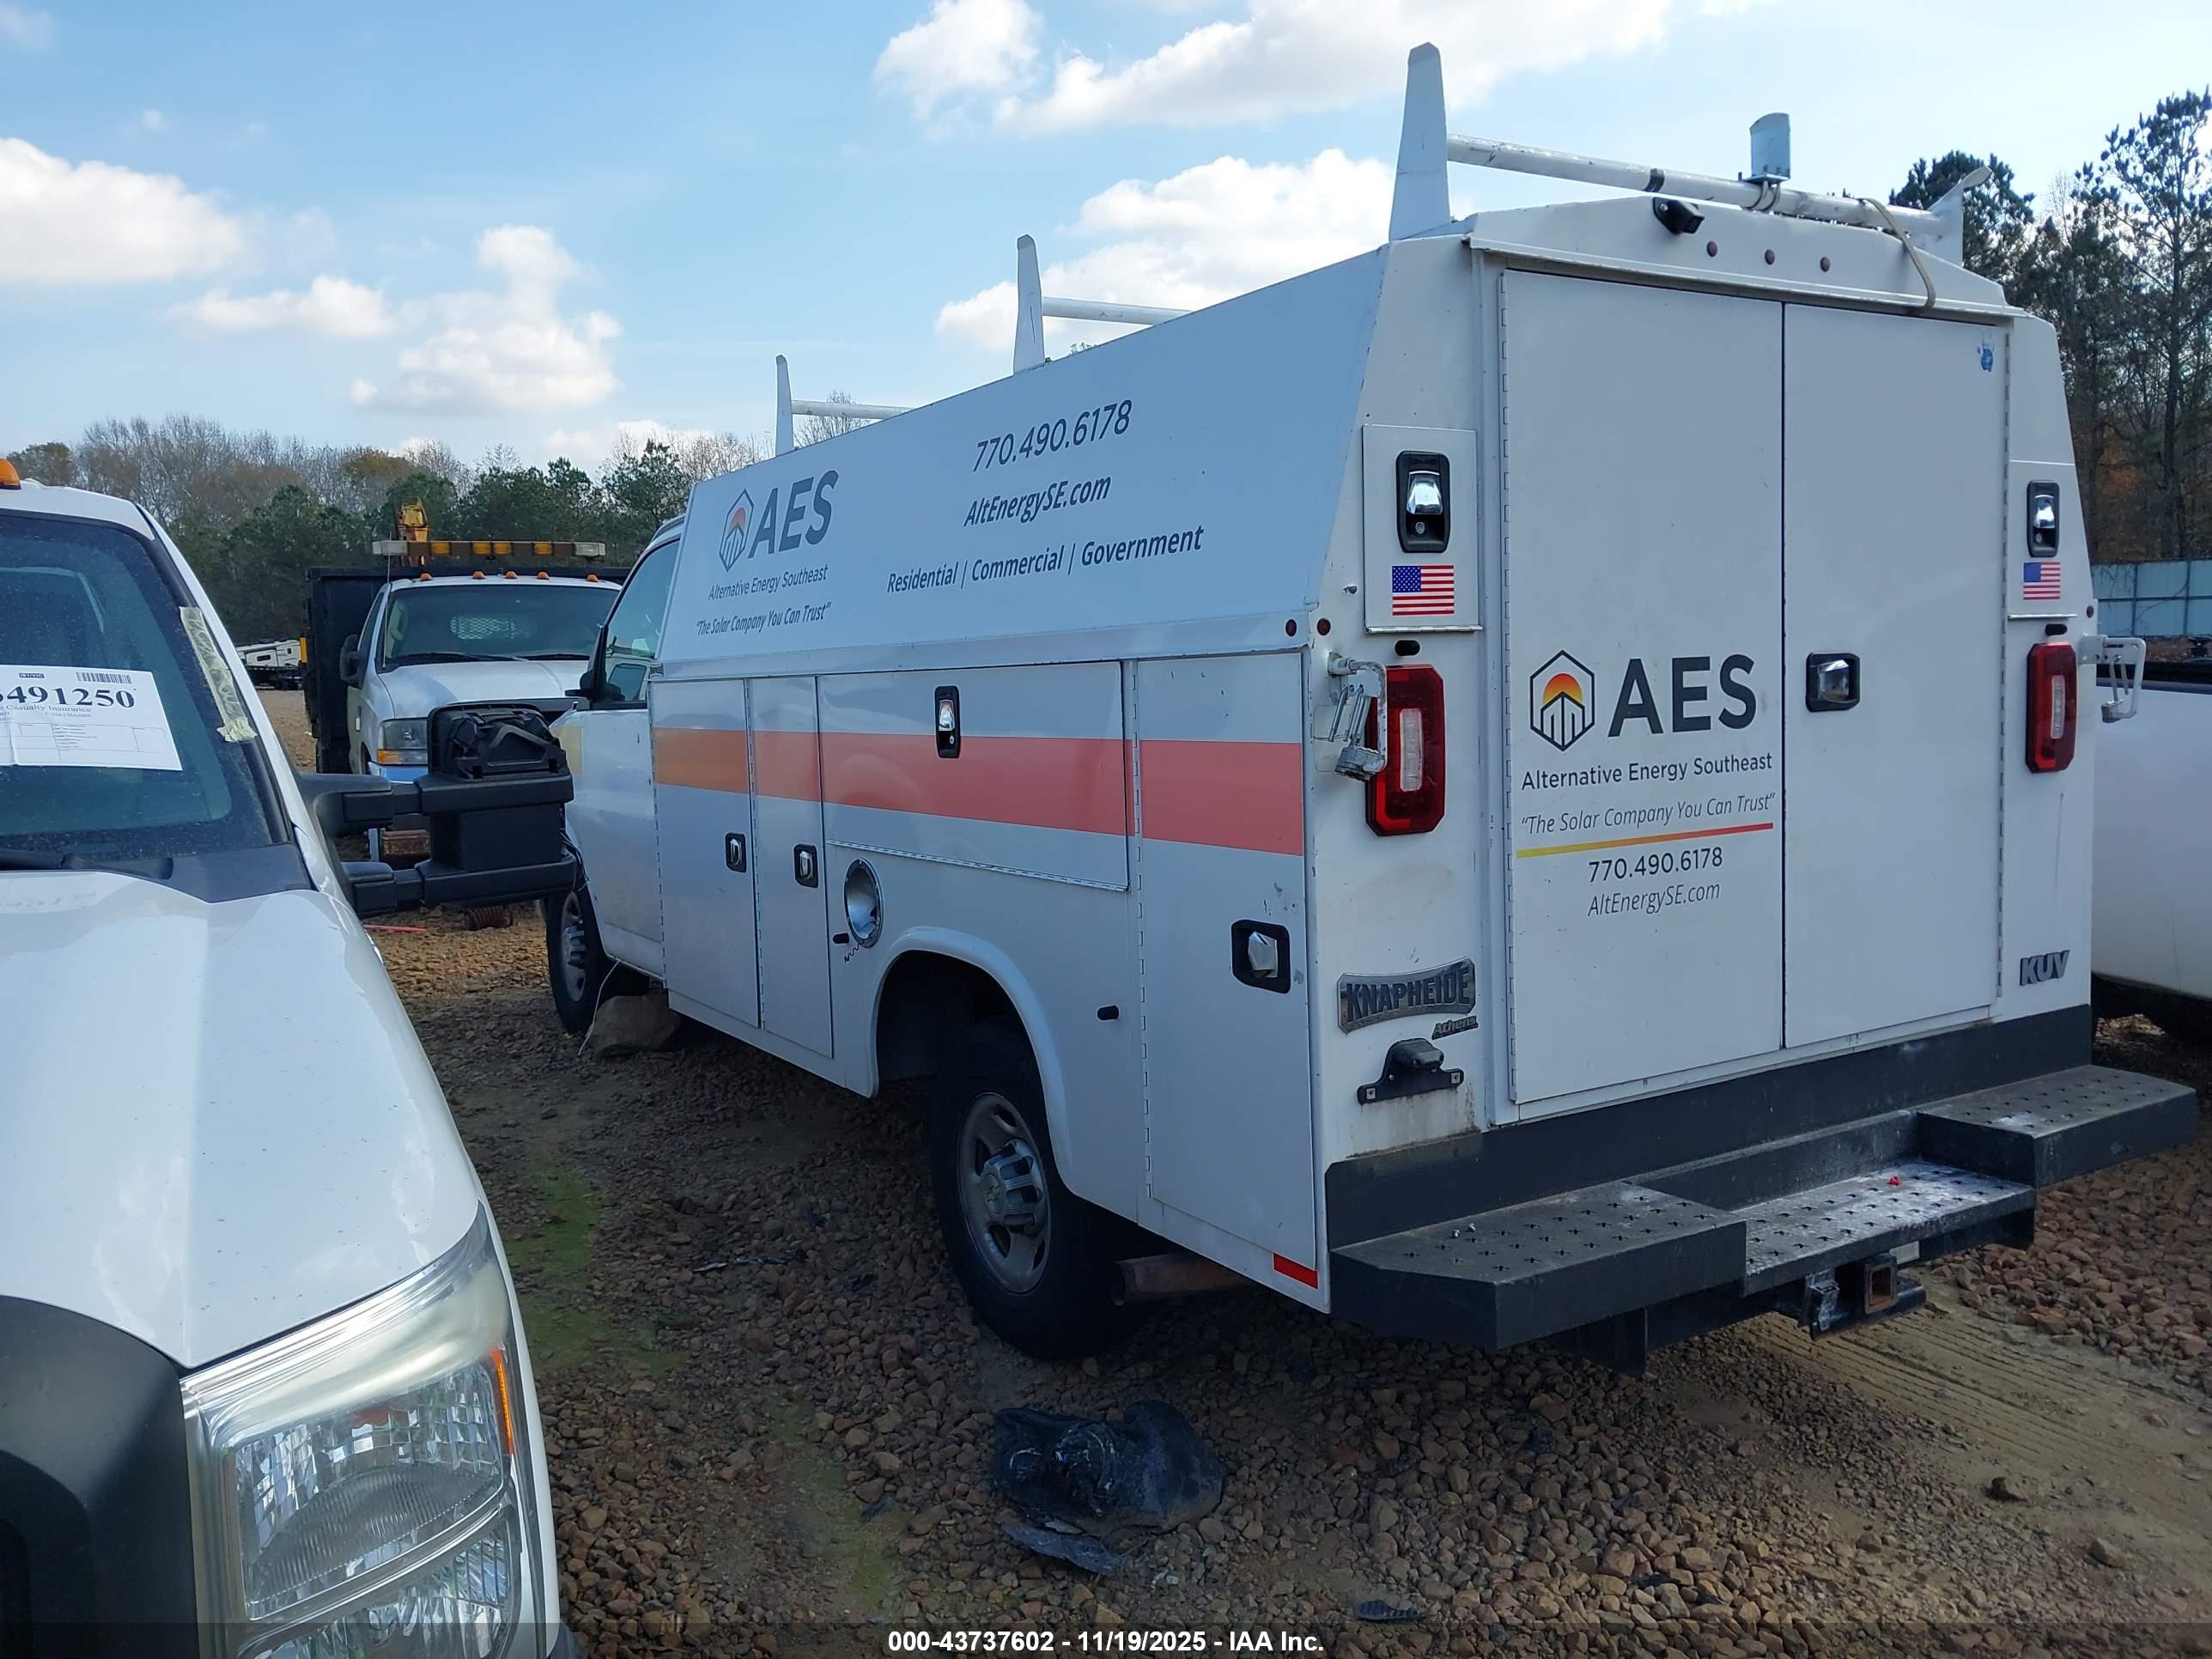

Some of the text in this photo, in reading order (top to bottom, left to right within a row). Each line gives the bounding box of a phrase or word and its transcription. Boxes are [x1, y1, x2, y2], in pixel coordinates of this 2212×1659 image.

[973, 399, 1133, 472] 770.490.6178
[748, 470, 839, 559] AES
[964, 476, 1111, 527] AltEnergySE.com
[887, 565, 957, 593] Residential
[972, 544, 1065, 582] Commercial
[1082, 525, 1204, 567] Government
[708, 563, 829, 600] Alternative Energy Southeast
[711, 617, 730, 634] Solar
[731, 612, 766, 635] Company
[768, 610, 781, 627] You
[784, 607, 800, 623] Can
[0, 686, 135, 708] 491250
[1607, 654, 1757, 738] AES
[1522, 752, 1772, 790] Alternative Energy Southeast
[1559, 811, 1600, 832] Solar
[1604, 804, 1673, 827] Company
[1677, 800, 1701, 818] You
[1706, 797, 1732, 816] Can
[1589, 846, 1723, 883] 770.490.6178
[1587, 883, 1720, 917] AltEnergySE.com
[2020, 949, 2070, 987] KUV
[1346, 965, 1470, 1023] KNAPHEIDE
